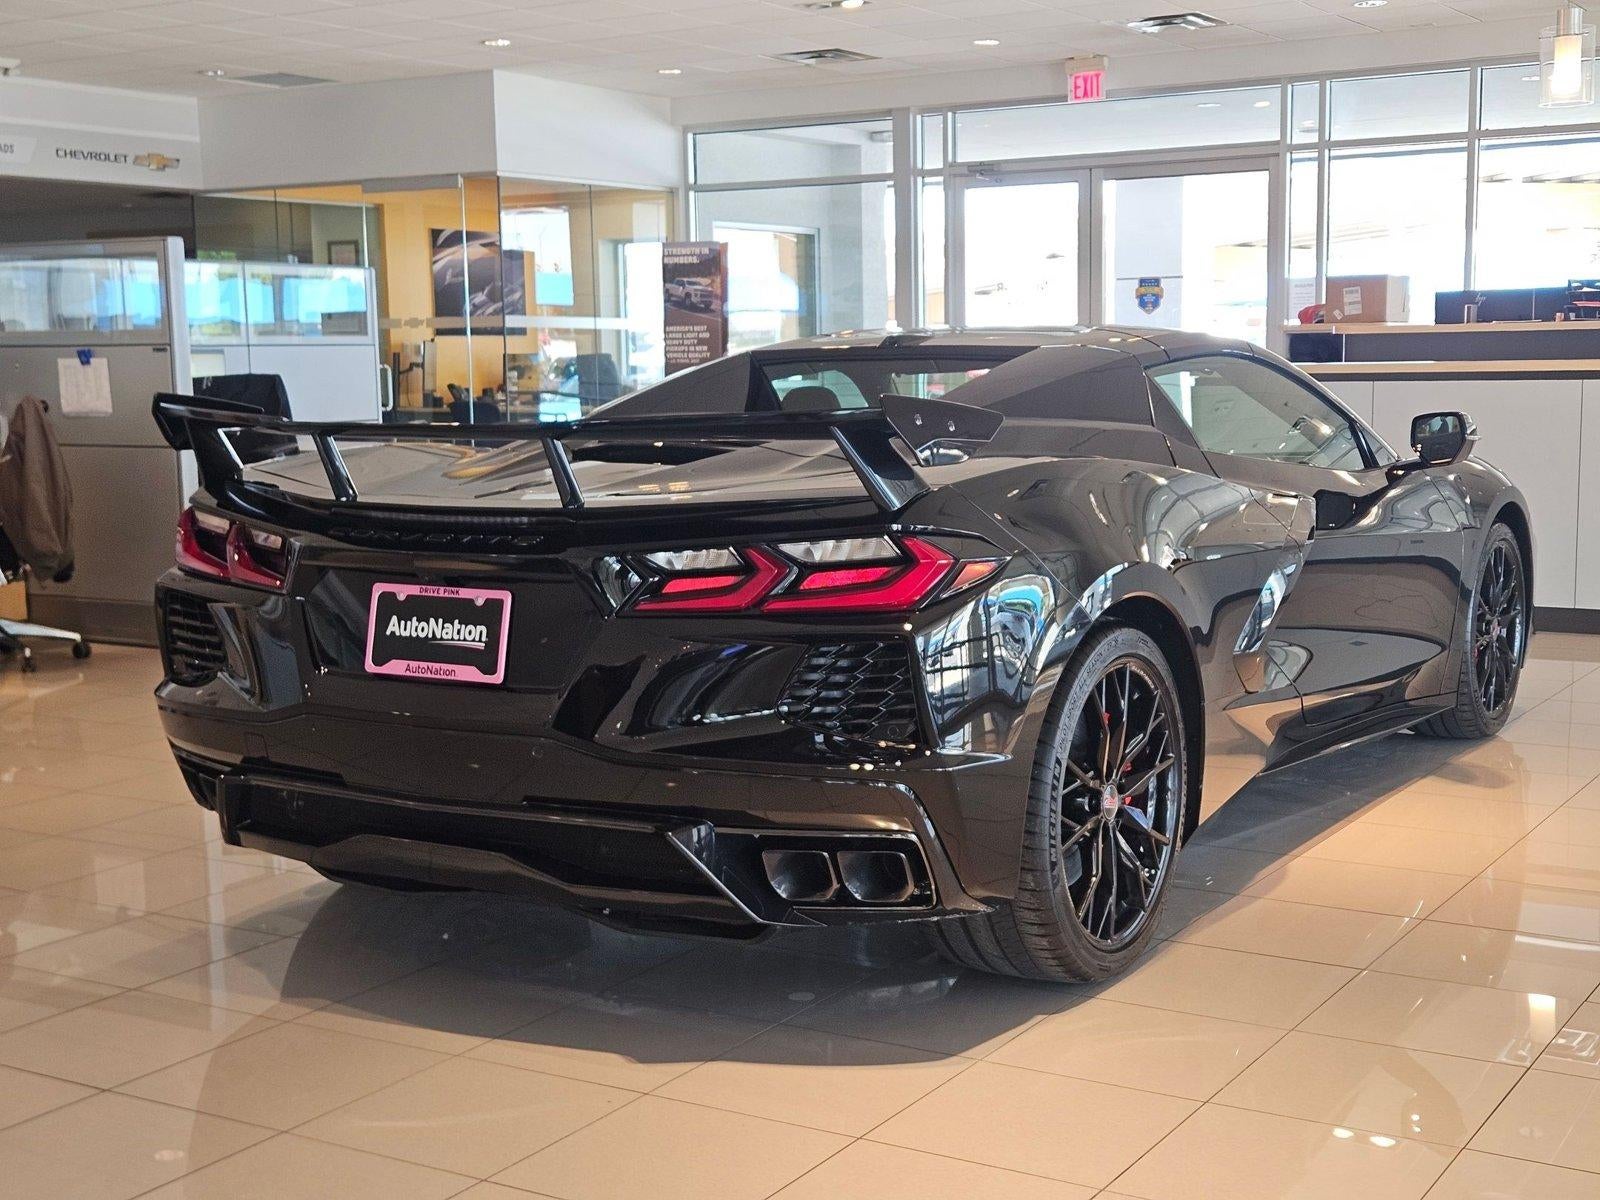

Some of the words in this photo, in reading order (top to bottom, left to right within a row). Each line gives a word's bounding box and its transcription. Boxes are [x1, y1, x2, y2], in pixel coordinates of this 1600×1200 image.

[1074, 73, 1101, 99] EXIT
[55, 148, 129, 164] CHEVROLET
[664, 247, 700, 256] STRENGTH
[701, 247, 710, 255] IN
[664, 255, 700, 264] NUMBERS.
[419, 586, 441, 595] DRIVE
[442, 588, 460, 596] PINK
[386, 614, 487, 642] AutoNation
[404, 663, 456, 677] AutoNation
[1050, 760, 1061, 862] MICHELIN
